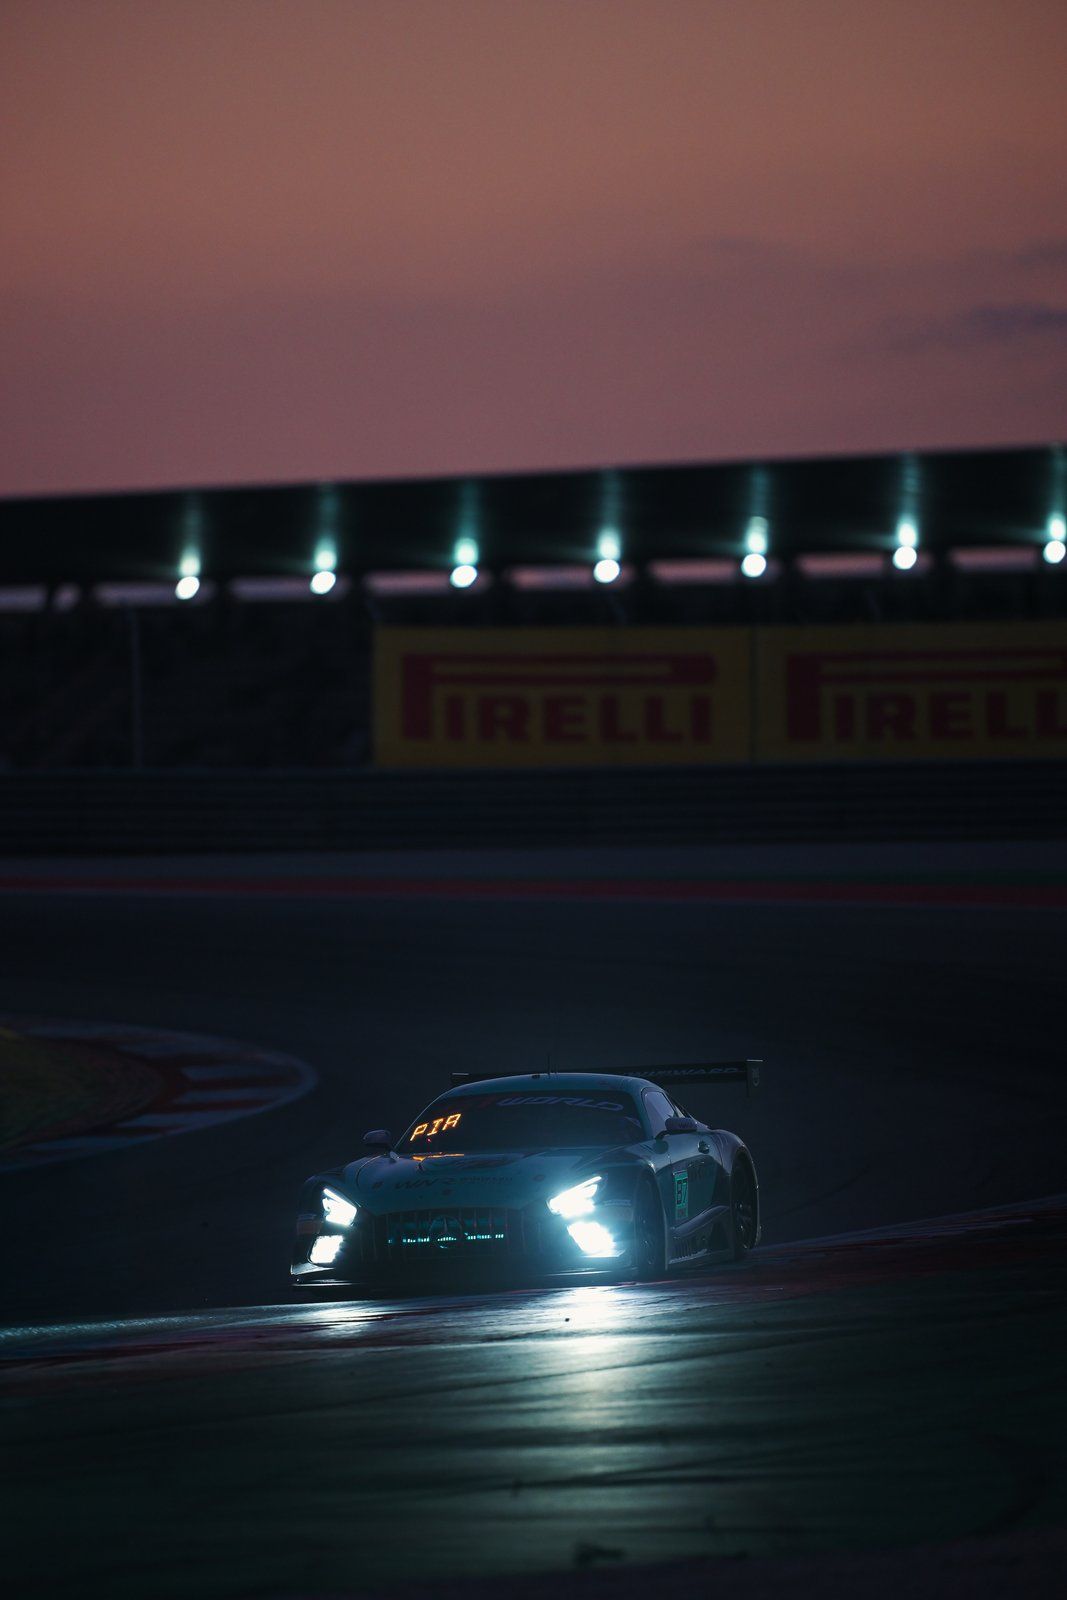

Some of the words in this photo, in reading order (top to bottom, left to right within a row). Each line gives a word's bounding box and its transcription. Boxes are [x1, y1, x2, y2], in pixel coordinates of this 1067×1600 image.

[403, 653, 717, 742] PIRELLI
[786, 650, 1067, 741] PIRELL
[410, 1113, 463, 1142] PIA
[496, 1096, 624, 1112] WORLD
